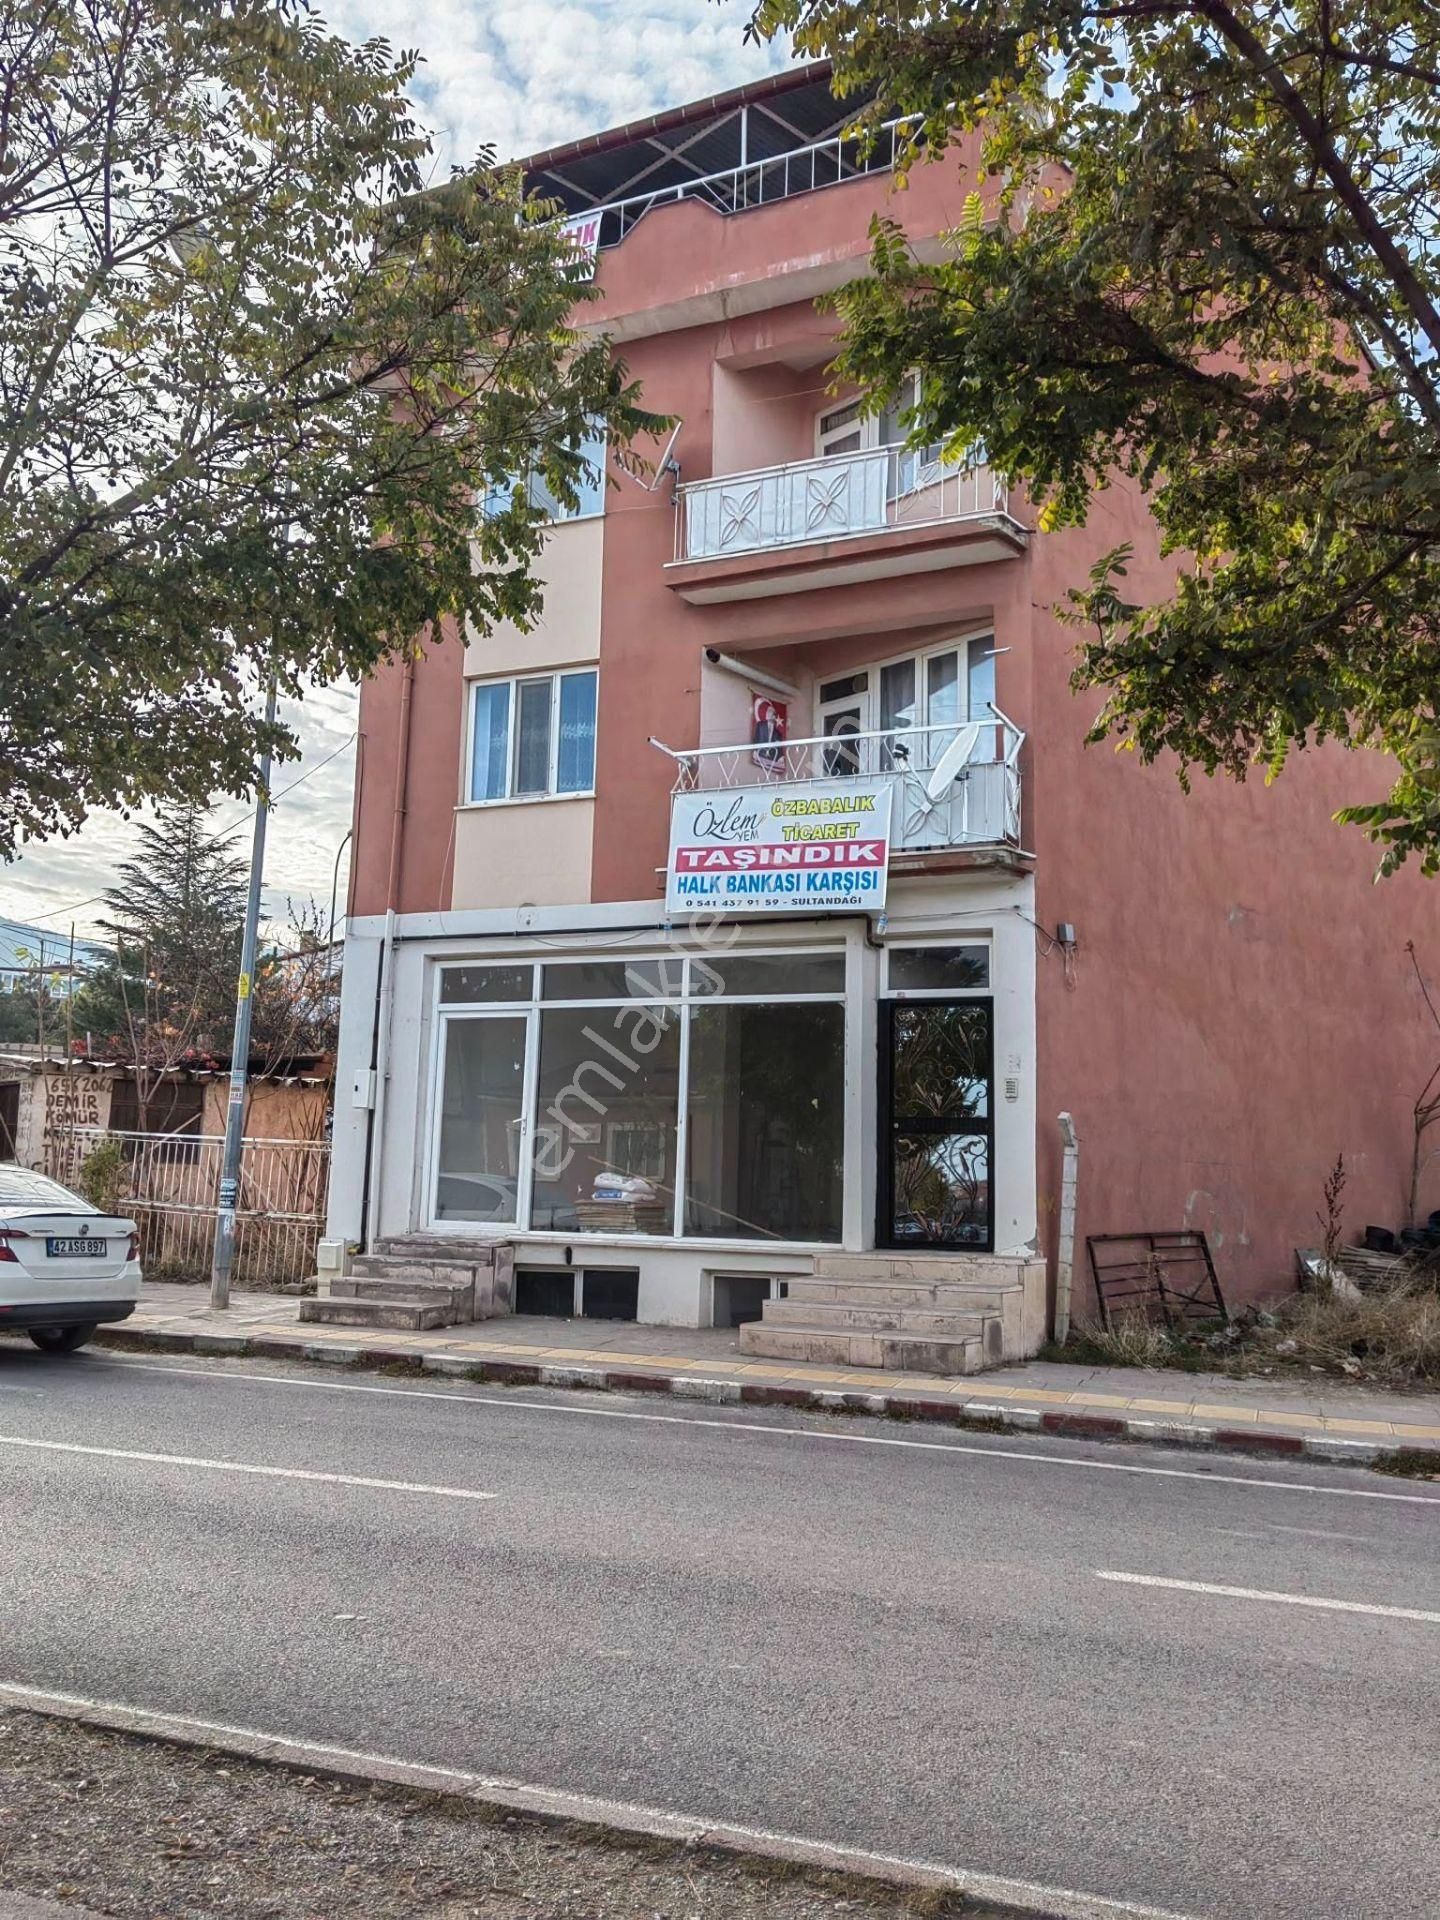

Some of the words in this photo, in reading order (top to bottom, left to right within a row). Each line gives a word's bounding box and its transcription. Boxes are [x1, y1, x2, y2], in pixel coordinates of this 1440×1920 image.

[771, 795, 876, 816] ÖZBABALIK
[693, 796, 768, 840] Özlem
[737, 829, 760, 842] YEM
[782, 822, 860, 841] TİCARET
[681, 843, 880, 870] TAŞINDIK
[677, 874, 721, 894] HALK
[726, 873, 800, 893] BANKASI
[806, 870, 878, 896] KARŞISI
[685, 899, 693, 907] 0
[697, 899, 717, 907] 541
[721, 899, 742, 907] 437
[747, 899, 760, 907] 91
[764, 898, 779, 906] 59
[791, 896, 862, 906] SULTANDAĞI
[46, 1094, 98, 1109] DEMİR
[45, 1109, 99, 1125] KÖMÜR
[54, 1240, 66, 1252] 42
[68, 1240, 86, 1252] ASG
[87, 1240, 104, 1252] 897
